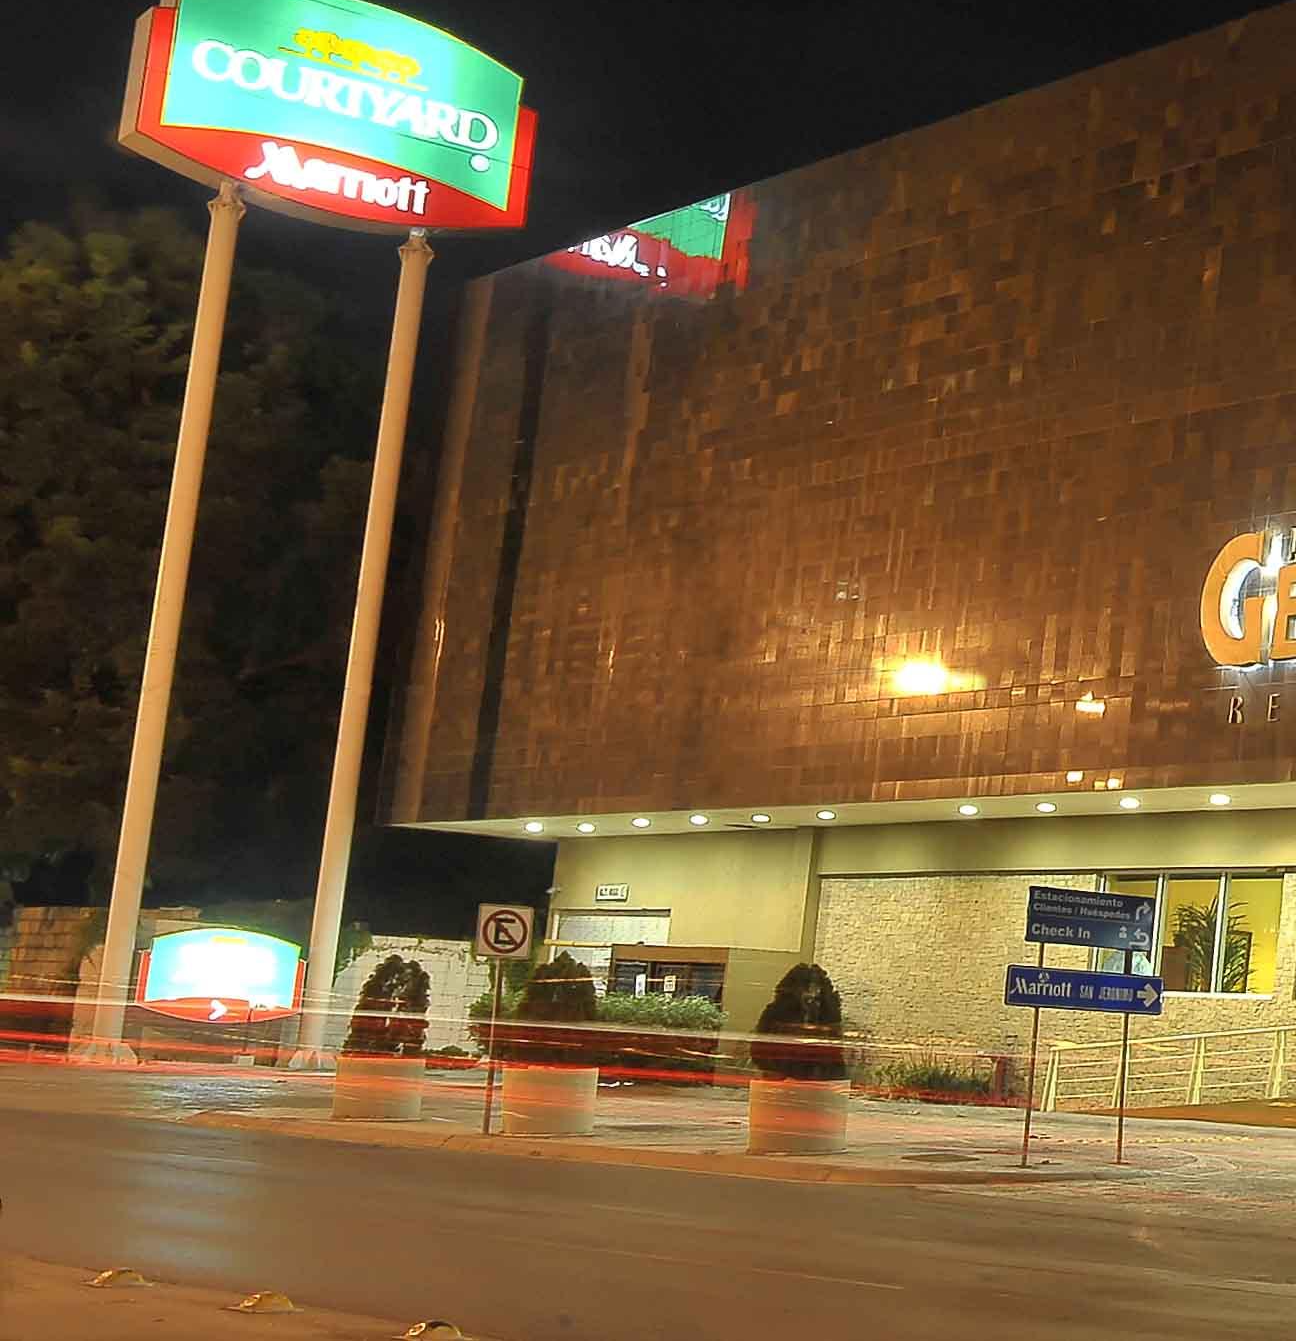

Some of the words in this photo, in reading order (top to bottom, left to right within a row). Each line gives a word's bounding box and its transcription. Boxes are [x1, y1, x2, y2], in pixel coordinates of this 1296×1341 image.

[192, 39, 499, 151] COURTYARD
[244, 141, 430, 215] Marriott
[1034, 890, 1124, 908] Estacionamiento
[1032, 923, 1074, 937] Check
[1010, 977, 1073, 998] Marriott
